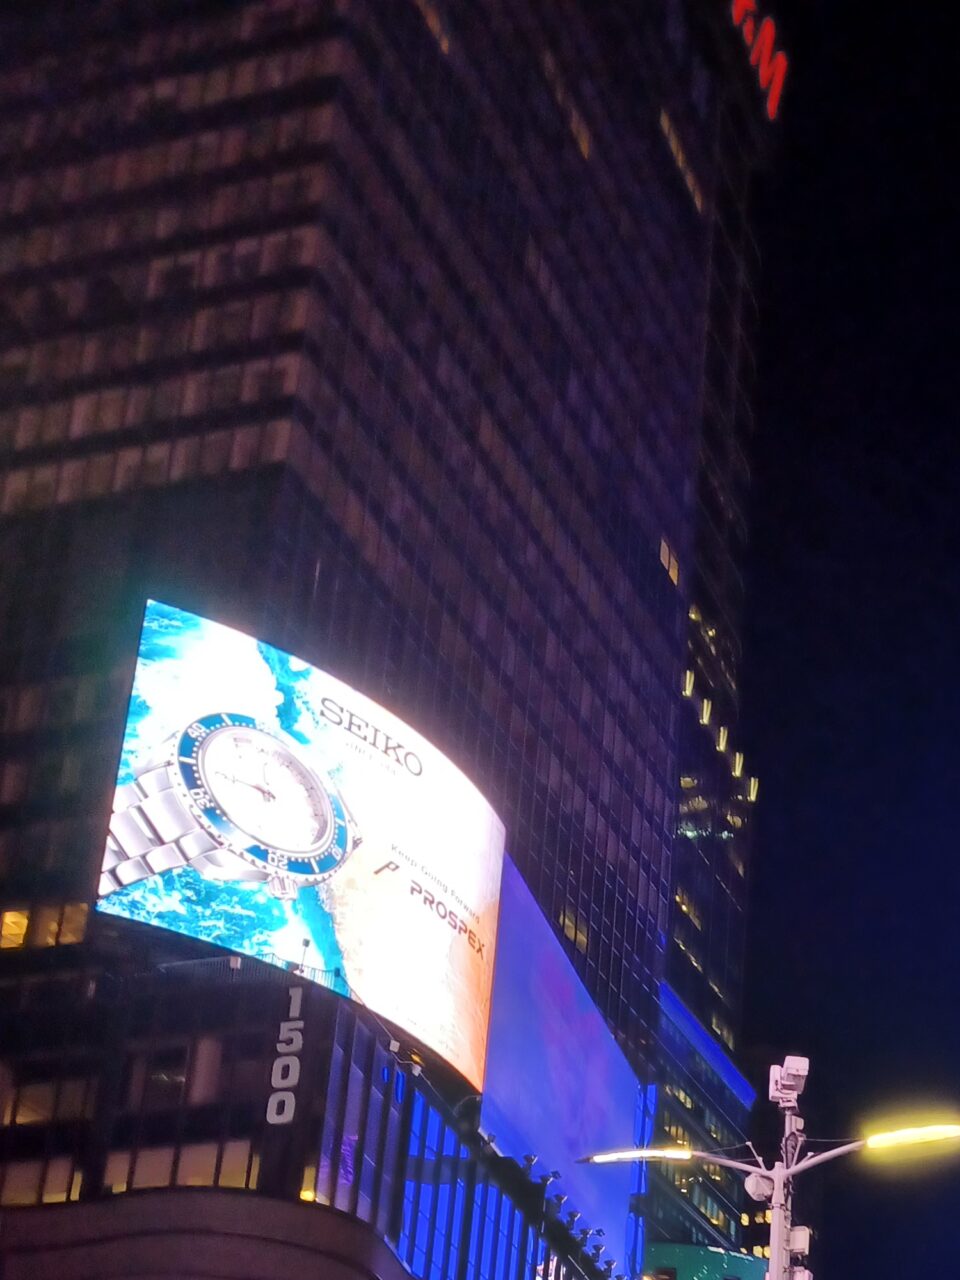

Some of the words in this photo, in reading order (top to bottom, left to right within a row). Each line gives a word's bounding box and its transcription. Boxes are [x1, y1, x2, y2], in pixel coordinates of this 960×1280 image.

[319, 697, 423, 777] SEIKO
[410, 879, 485, 960] PROSPEX
[265, 986, 304, 1126] 1500
